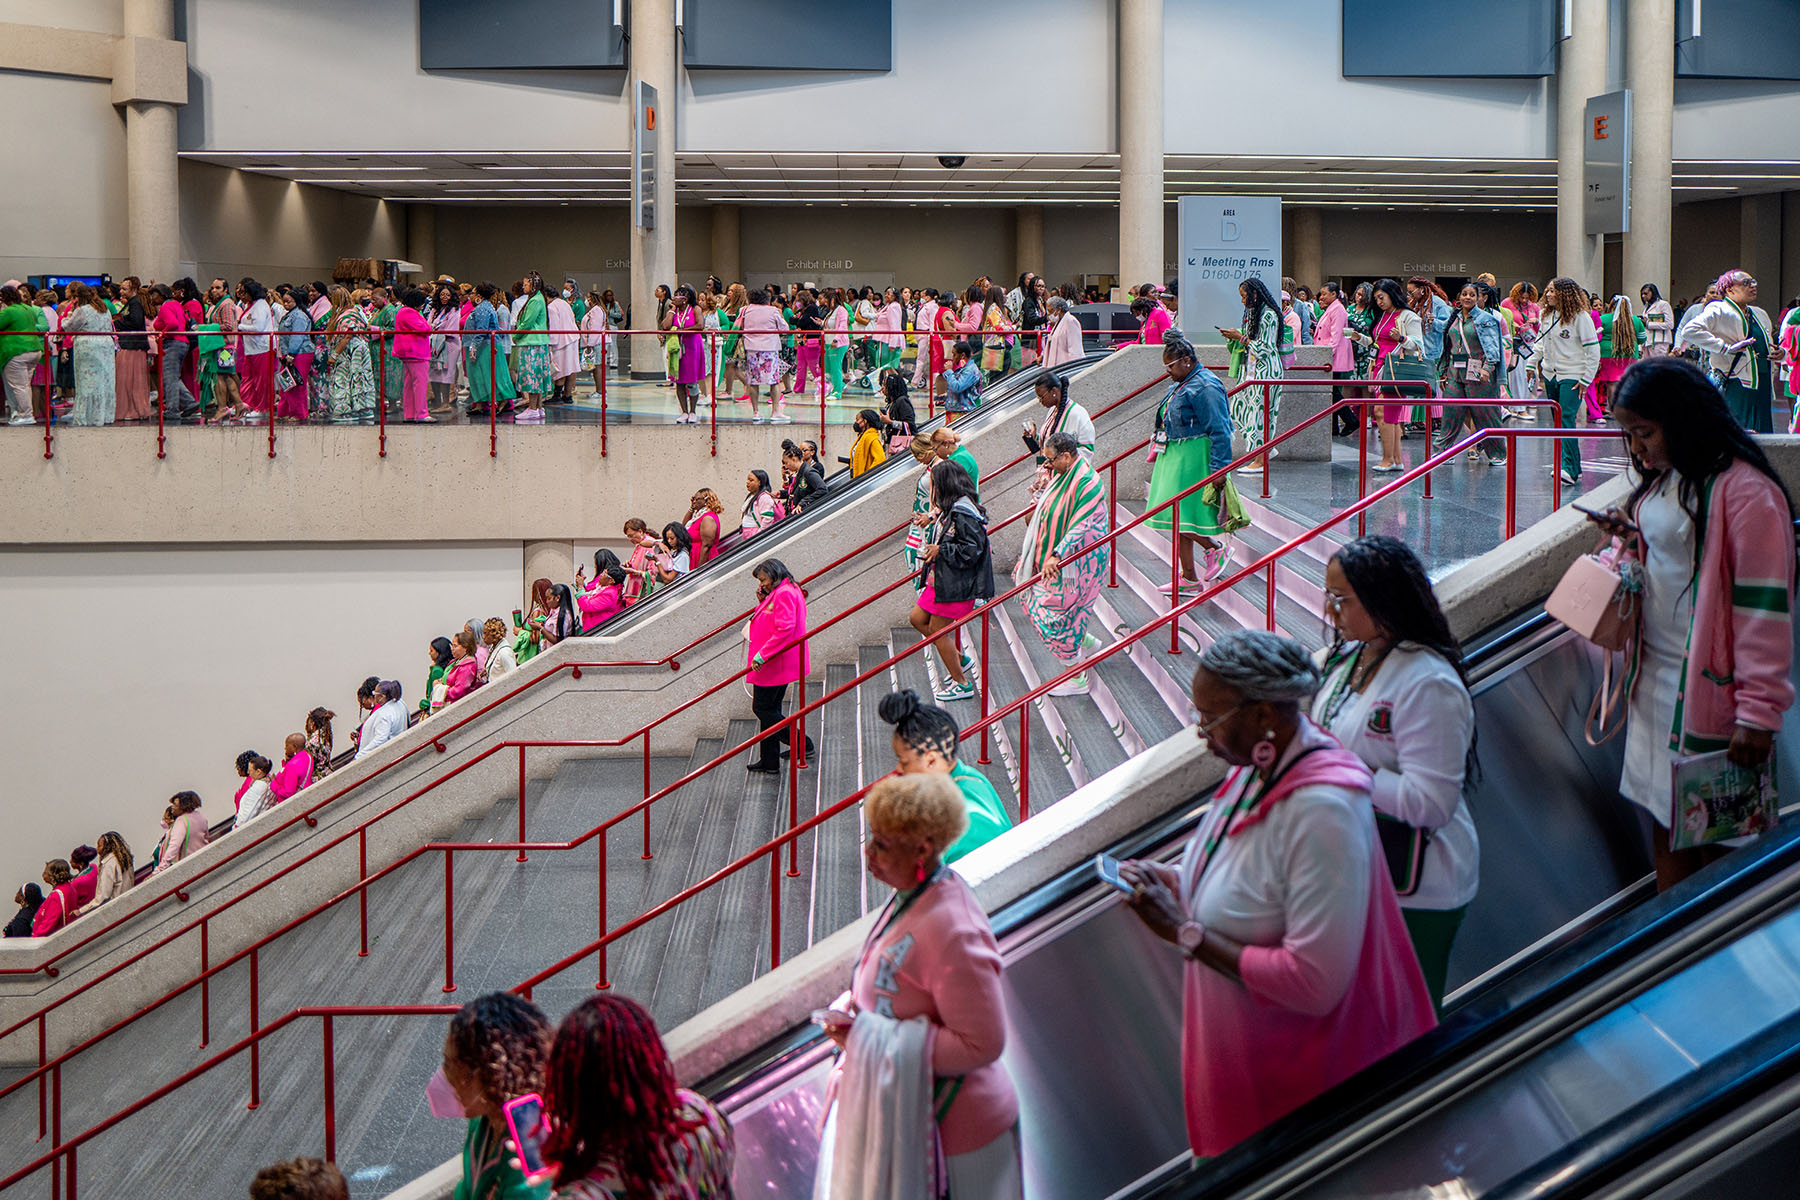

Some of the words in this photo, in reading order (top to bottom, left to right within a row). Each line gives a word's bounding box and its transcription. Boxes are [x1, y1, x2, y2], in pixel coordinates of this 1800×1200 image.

[645, 105, 656, 130] D
[1593, 115, 1609, 140] E
[1222, 209, 1236, 217] AREA
[1220, 219, 1241, 242] D
[786, 259, 819, 269] Exhibit
[823, 259, 842, 269] Hall
[844, 259, 854, 270] D
[1202, 257, 1246, 269] Meeting
[1249, 257, 1275, 268] Rms
[1403, 262, 1435, 273] Exhibit
[1438, 262, 1457, 273] Hall
[1459, 263, 1467, 273] E
[1202, 269, 1262, 280] D160-D175
